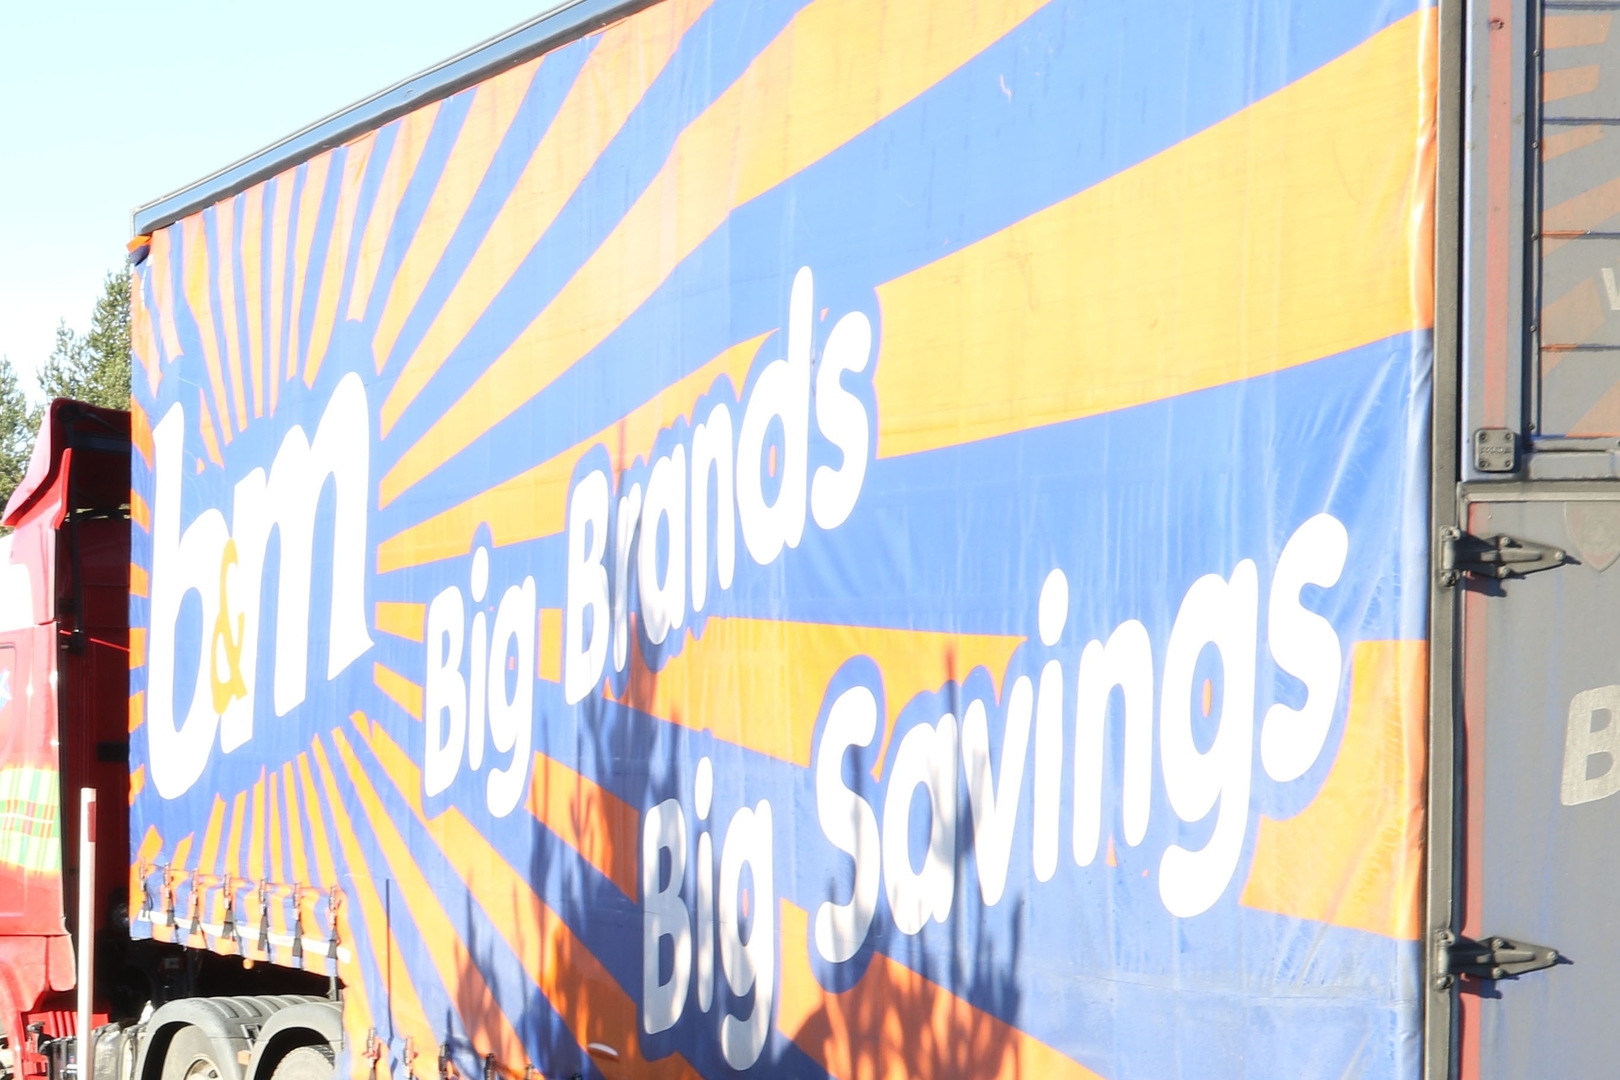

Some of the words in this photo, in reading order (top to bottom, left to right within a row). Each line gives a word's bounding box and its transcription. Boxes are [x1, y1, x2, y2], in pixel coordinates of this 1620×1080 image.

[147, 372, 374, 800] b&m
[423, 545, 536, 818] Big
[565, 265, 873, 706] Brands
[642, 756, 774, 1071] Big
[814, 512, 1349, 964] Savings
